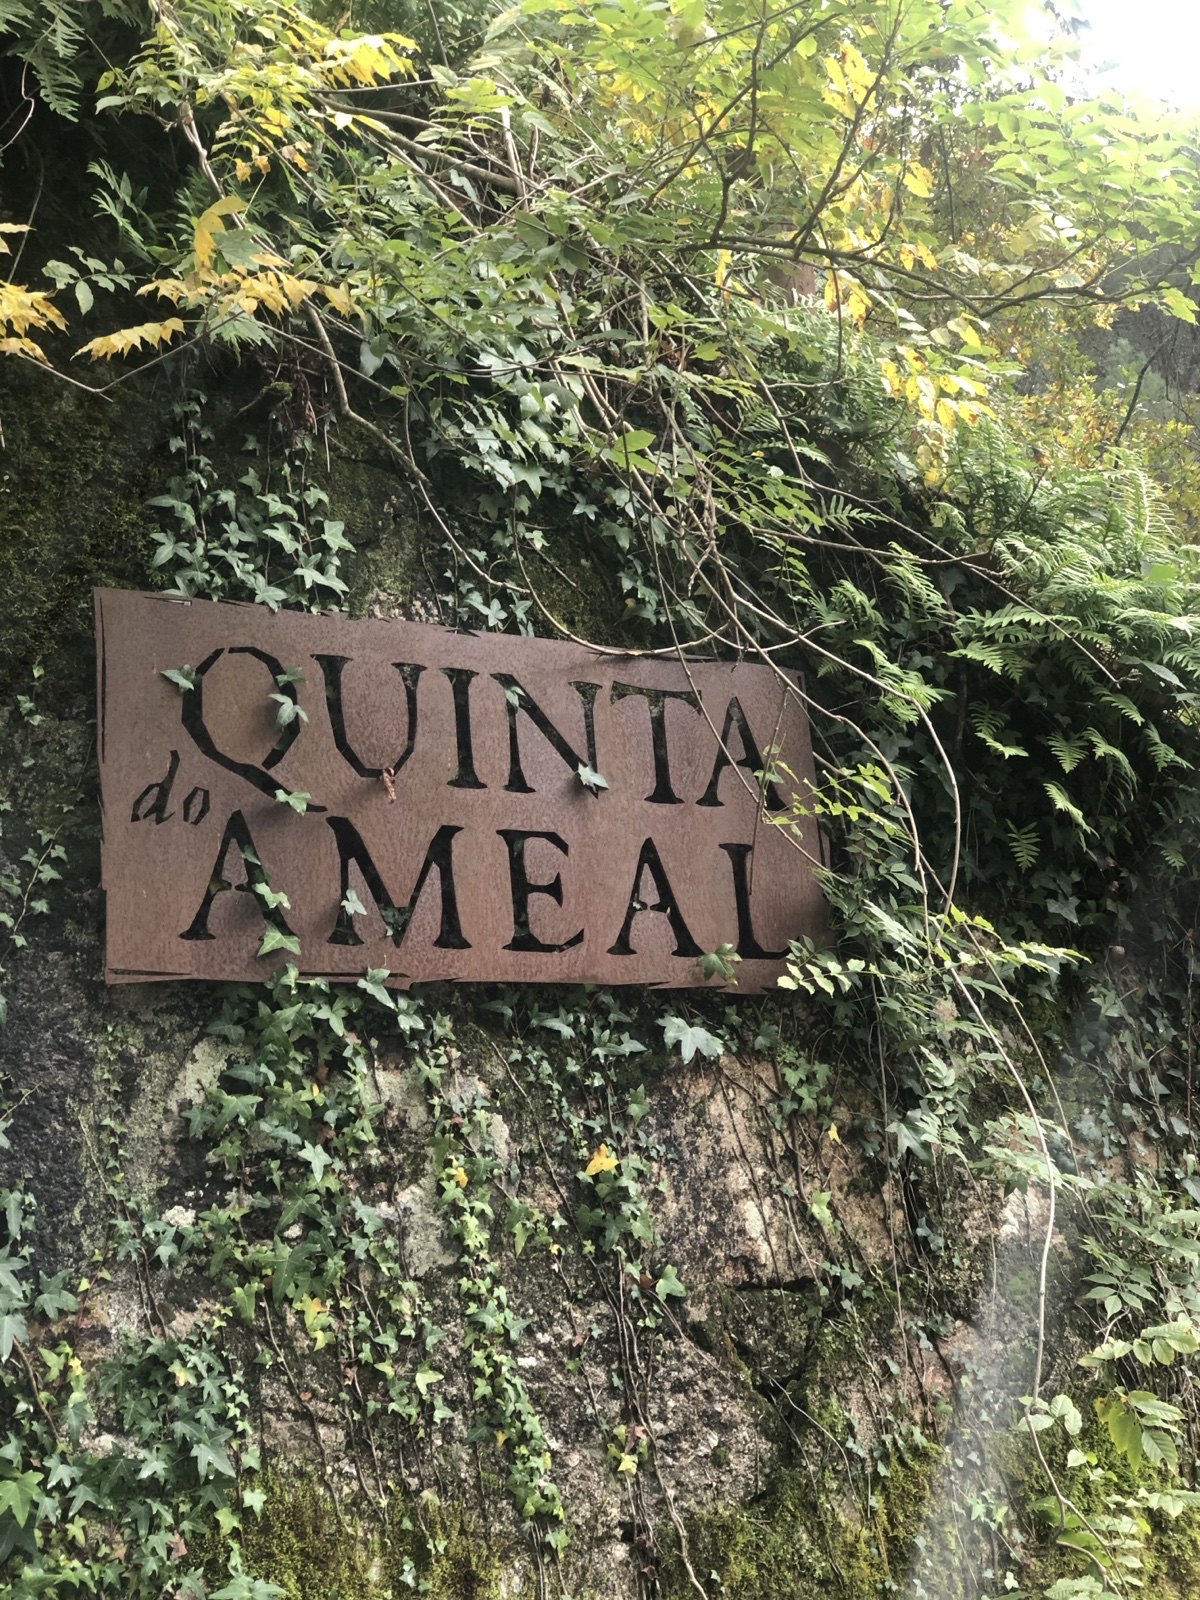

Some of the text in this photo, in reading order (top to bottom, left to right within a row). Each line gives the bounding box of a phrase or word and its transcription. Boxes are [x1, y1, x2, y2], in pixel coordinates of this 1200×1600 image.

[130, 749, 211, 825] do
[181, 646, 788, 812] QUINTA
[178, 809, 796, 959] AMEAL
